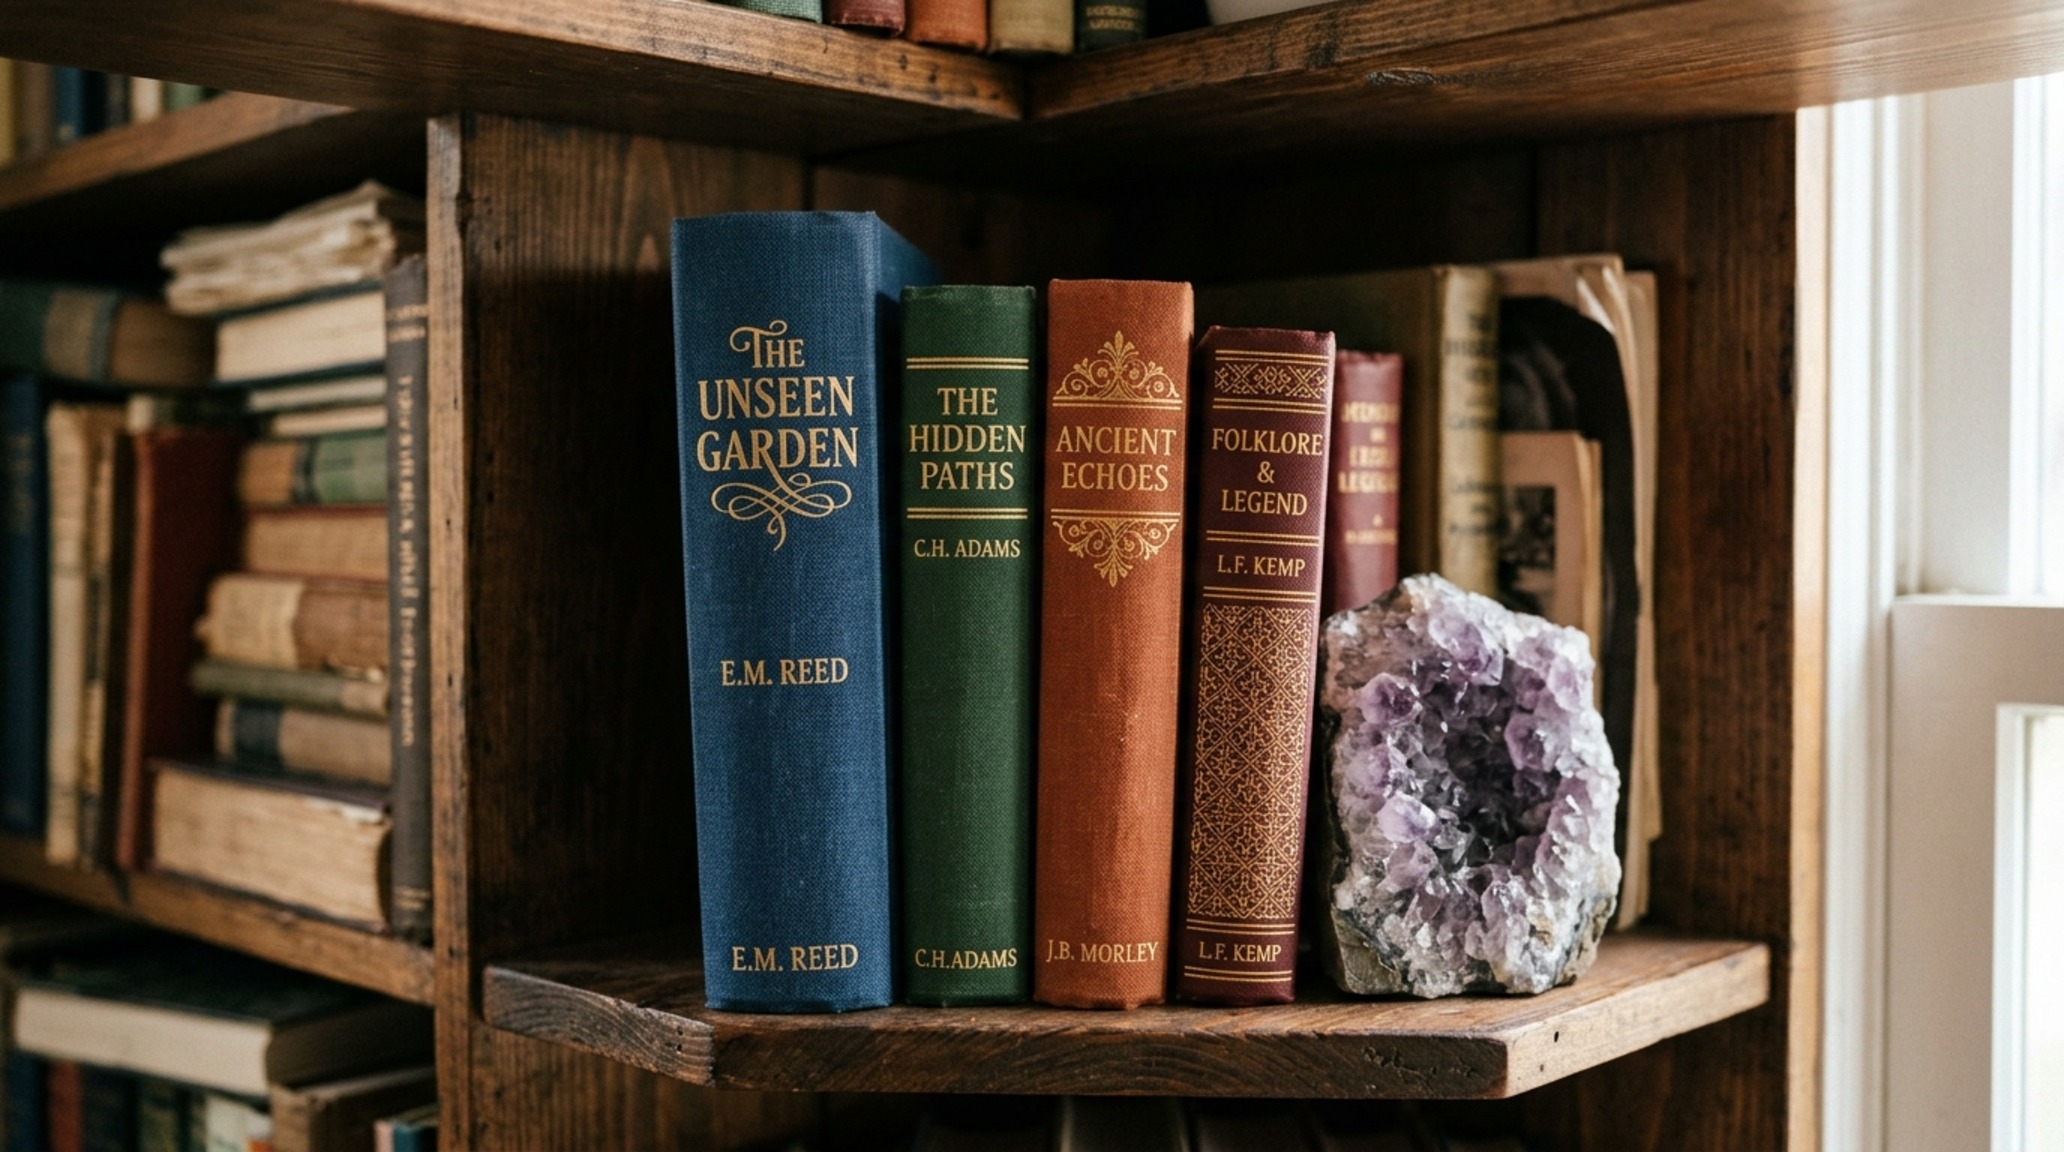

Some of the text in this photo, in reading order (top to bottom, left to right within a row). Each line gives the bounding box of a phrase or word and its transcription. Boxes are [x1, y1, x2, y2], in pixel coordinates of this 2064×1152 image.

[729, 319, 805, 369] THE
[698, 376, 855, 421] UNSEEN
[937, 387, 998, 416] THE
[696, 427, 859, 472] GARDEN
[909, 424, 1026, 453] HIDDEN
[1055, 425, 1176, 456] ANCIENT
[1211, 427, 1323, 456] FOLKLORE
[920, 461, 1015, 490] PATHS
[1061, 462, 1169, 491] ECHOES
[1257, 461, 1275, 483] &
[1221, 489, 1308, 516] LEGEND
[914, 538, 1020, 557] C.H. ADAMS
[1217, 554, 1305, 577] L.F. KEMP
[720, 657, 848, 686] E.M. REED
[732, 944, 859, 971] E.M. REED
[1046, 939, 1159, 963] J.B. MORLEY
[1233, 944, 1281, 962] KEMP
